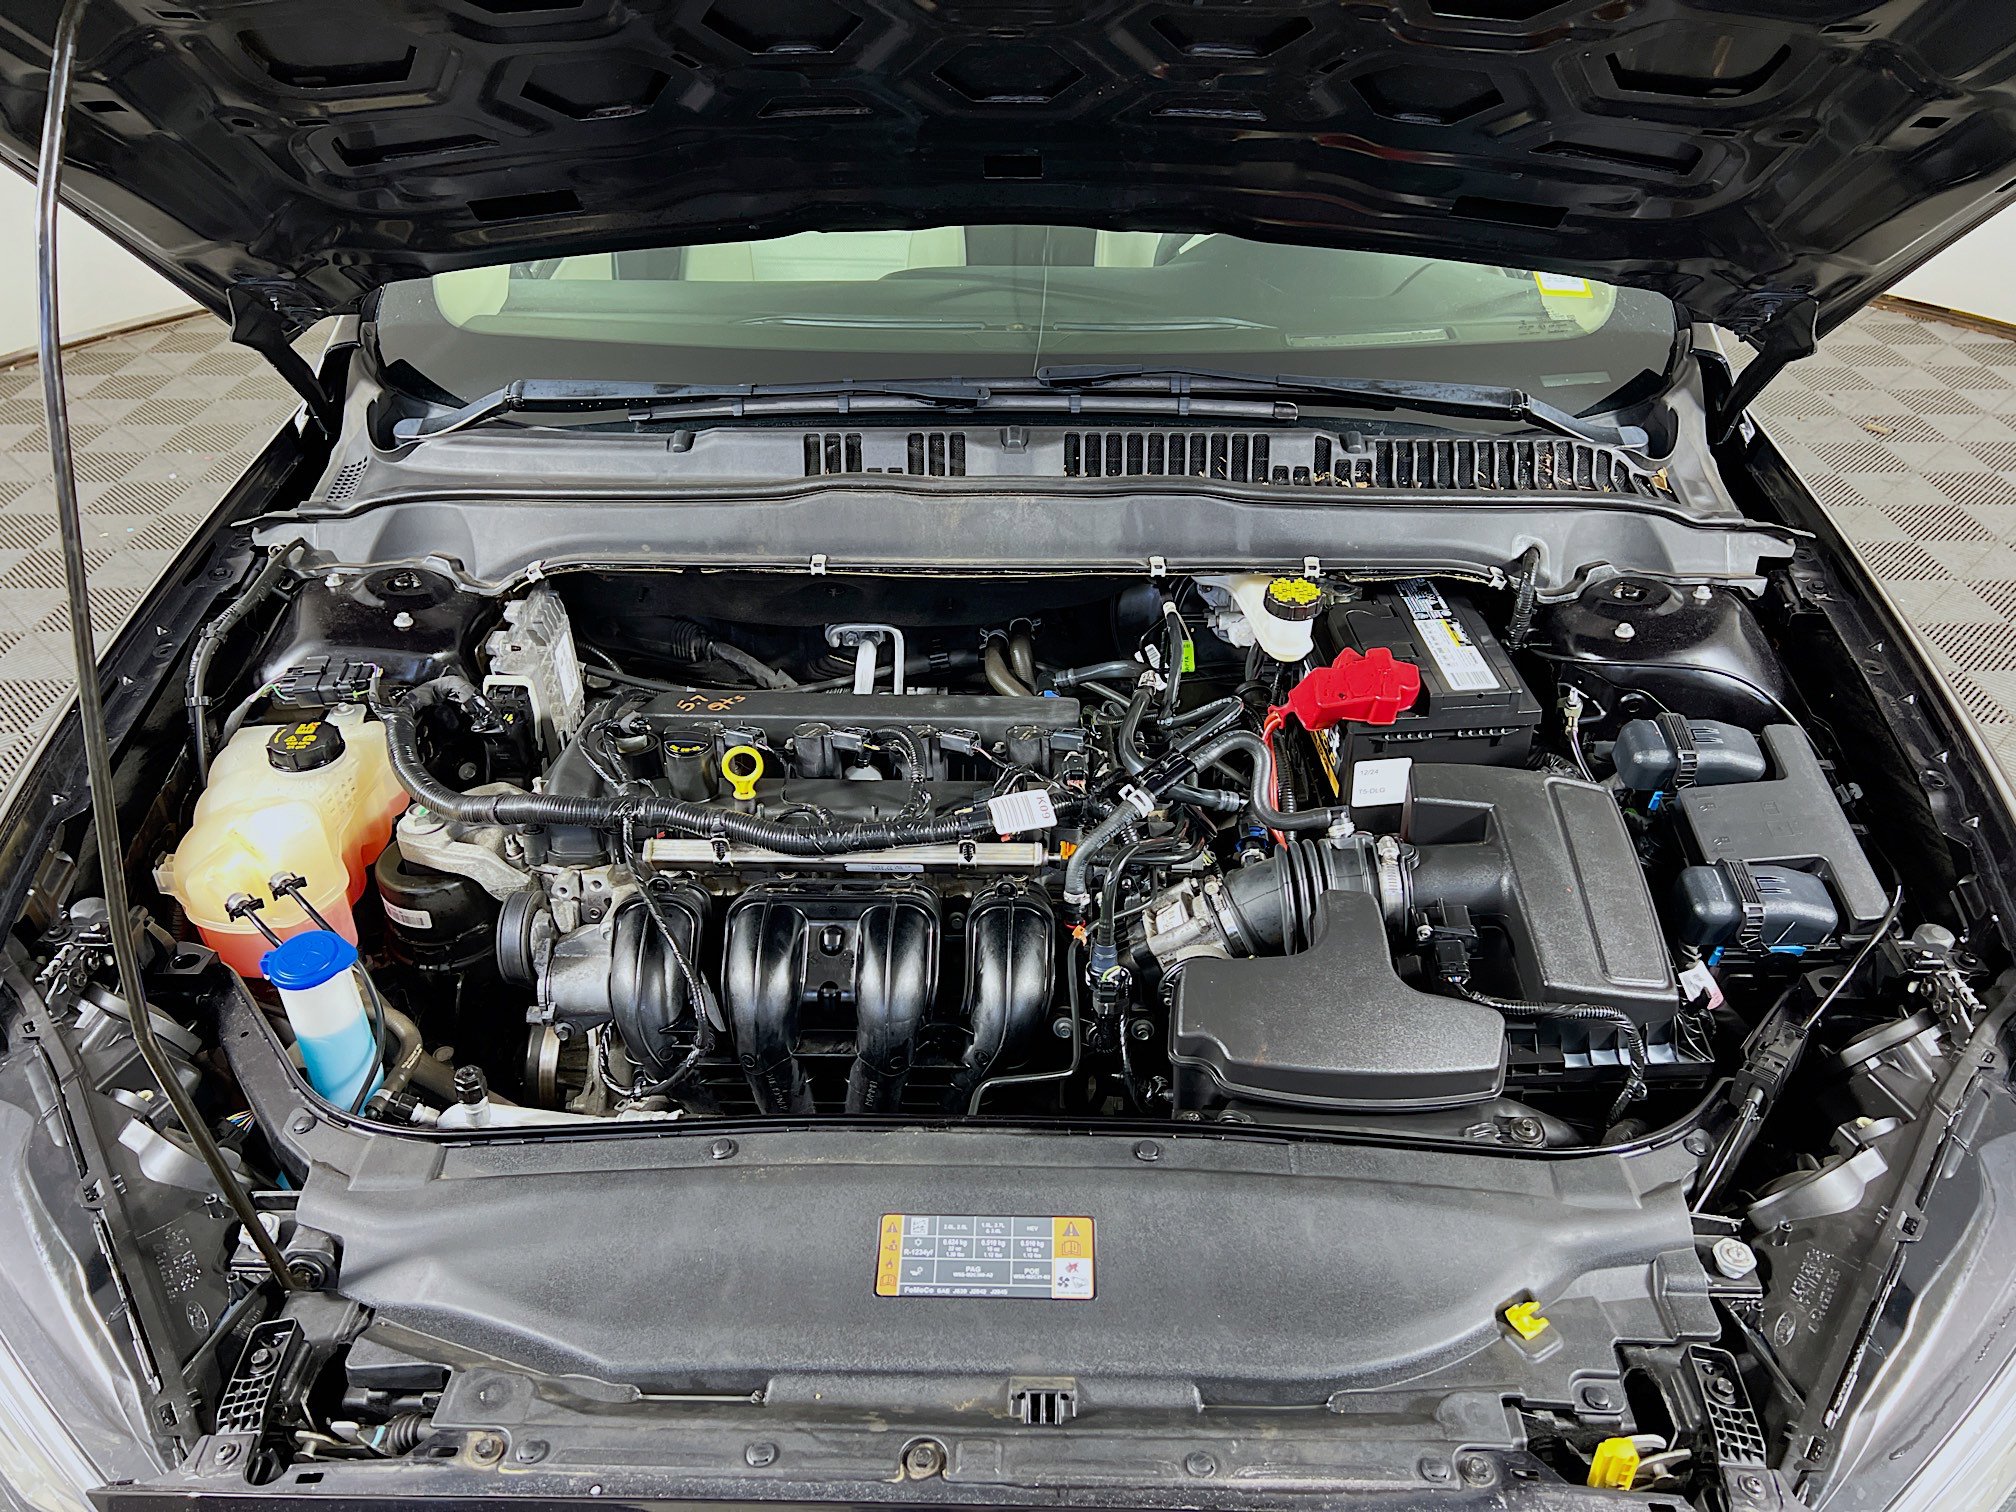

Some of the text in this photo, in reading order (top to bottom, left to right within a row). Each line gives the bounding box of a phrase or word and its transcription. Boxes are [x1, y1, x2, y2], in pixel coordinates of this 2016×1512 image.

[676, 694, 709, 712] 5.7
[1036, 796, 1051, 819] K09
[960, 1239, 967, 1247] kg
[998, 1239, 1006, 1248] kg
[1036, 1240, 1044, 1248] kg
[903, 1248, 934, 1257] R-1234yf
[965, 1265, 981, 1273] PAG
[903, 1286, 935, 1294] FoMoCo
